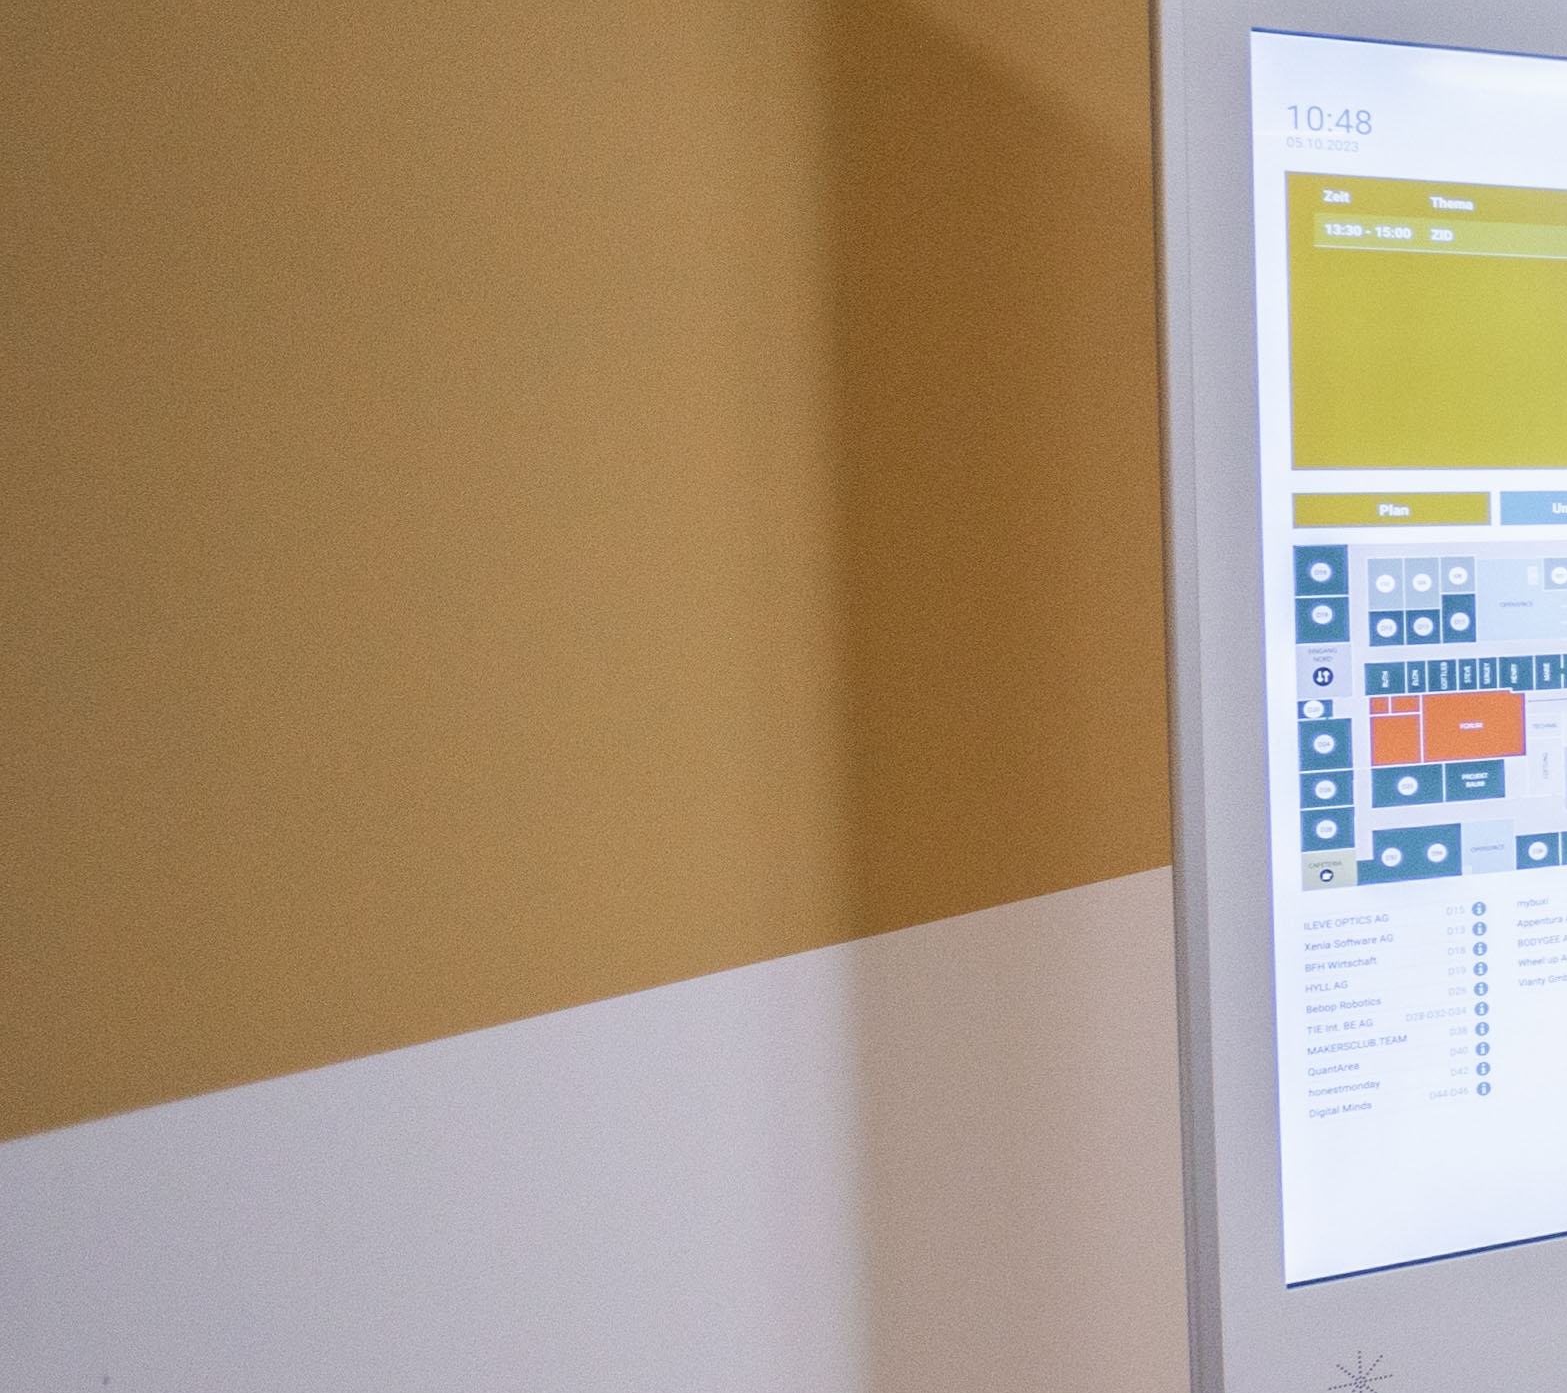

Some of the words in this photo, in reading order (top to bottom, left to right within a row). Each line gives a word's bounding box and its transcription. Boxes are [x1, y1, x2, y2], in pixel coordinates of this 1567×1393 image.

[1288, 105, 1372, 135] 10:48
[1286, 136, 1359, 152] 05.10.2023
[1323, 189, 1350, 203] Zeit
[1431, 196, 1473, 210] Thema
[1324, 224, 1362, 236] 13:30
[1375, 226, 1412, 239] 15:00
[1431, 228, 1453, 241] ZID
[1378, 503, 1410, 518] Plan
[1304, 919, 1332, 930] ILEVE
[1335, 916, 1372, 928] OPTICS
[1375, 914, 1389, 923] AG
[1517, 916, 1563, 928] Appentura
[1305, 942, 1331, 951] Xenia
[1334, 936, 1377, 949] Software
[1379, 934, 1394, 943] AG
[1305, 963, 1325, 972] BFH
[1328, 956, 1377, 969] Wirtschaft
[1518, 957, 1545, 967] Wheel
[1547, 957, 1559, 965] up
[1305, 983, 1331, 993] HYLL
[1334, 981, 1348, 990] AG
[1306, 1003, 1337, 1014] Bebop
[1340, 997, 1381, 1009] Robotics
[1307, 1025, 1322, 1035] TIE
[1343, 1021, 1356, 1030] BE
[1359, 1019, 1373, 1028] AG
[1308, 1063, 1360, 1076] QuantArea
[1308, 1080, 1380, 1097] honestmonday
[1309, 1107, 1339, 1119] Digital
[1342, 1101, 1372, 1113] Minds
